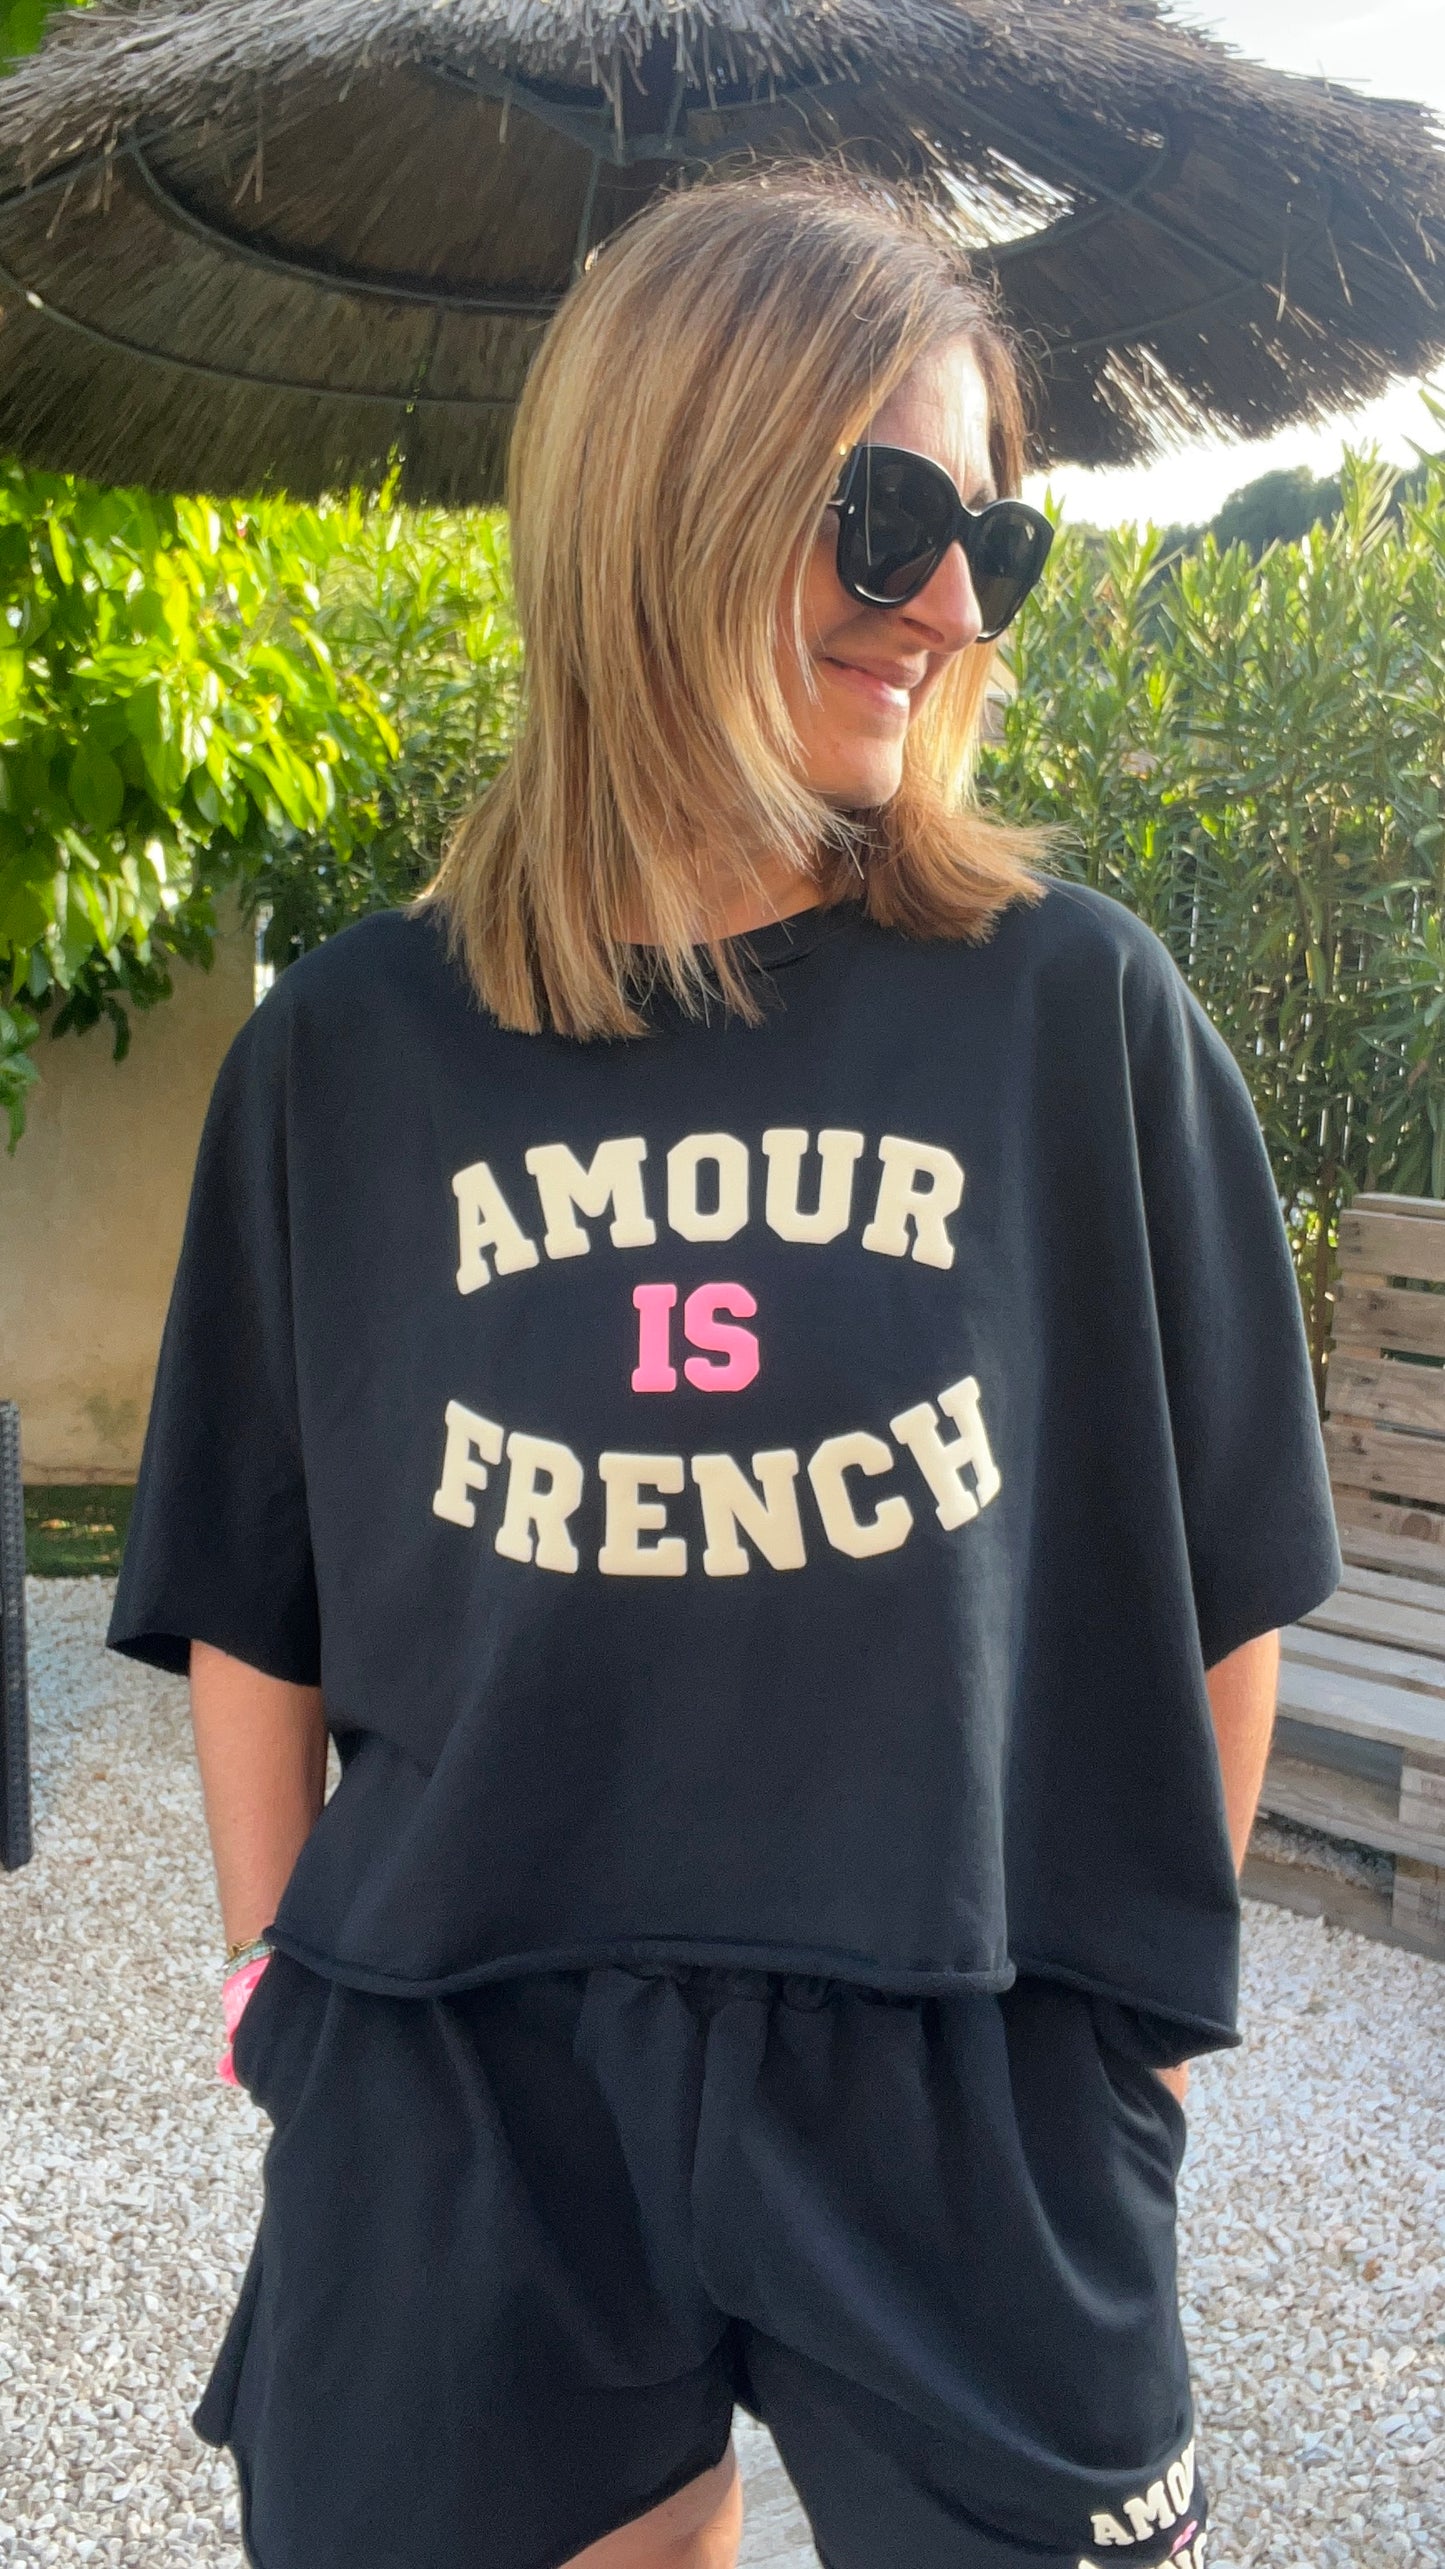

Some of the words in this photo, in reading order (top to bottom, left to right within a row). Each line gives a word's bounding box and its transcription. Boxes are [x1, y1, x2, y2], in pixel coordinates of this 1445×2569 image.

[451, 1127, 966, 1296] AMOUR
[630, 1282, 761, 1393] IS
[432, 1374, 1003, 1578] FRENCH
